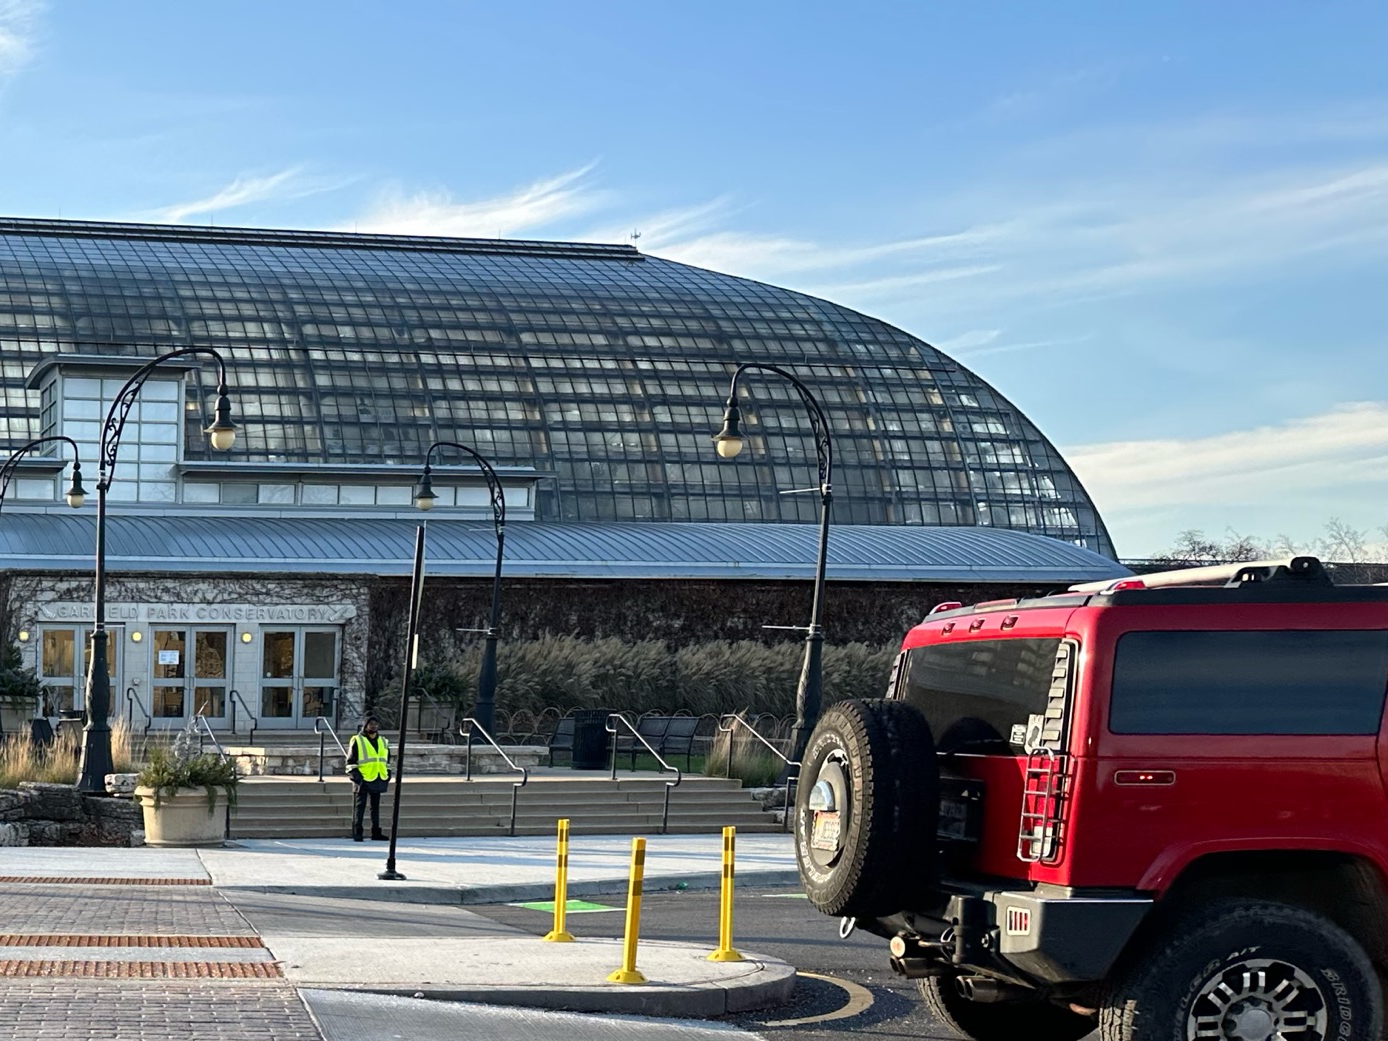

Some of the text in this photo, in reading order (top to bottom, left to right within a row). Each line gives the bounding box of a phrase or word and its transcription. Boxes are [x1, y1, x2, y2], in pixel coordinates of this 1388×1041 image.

[57, 605, 326, 620] GARELD PARK CONSERVATORY
